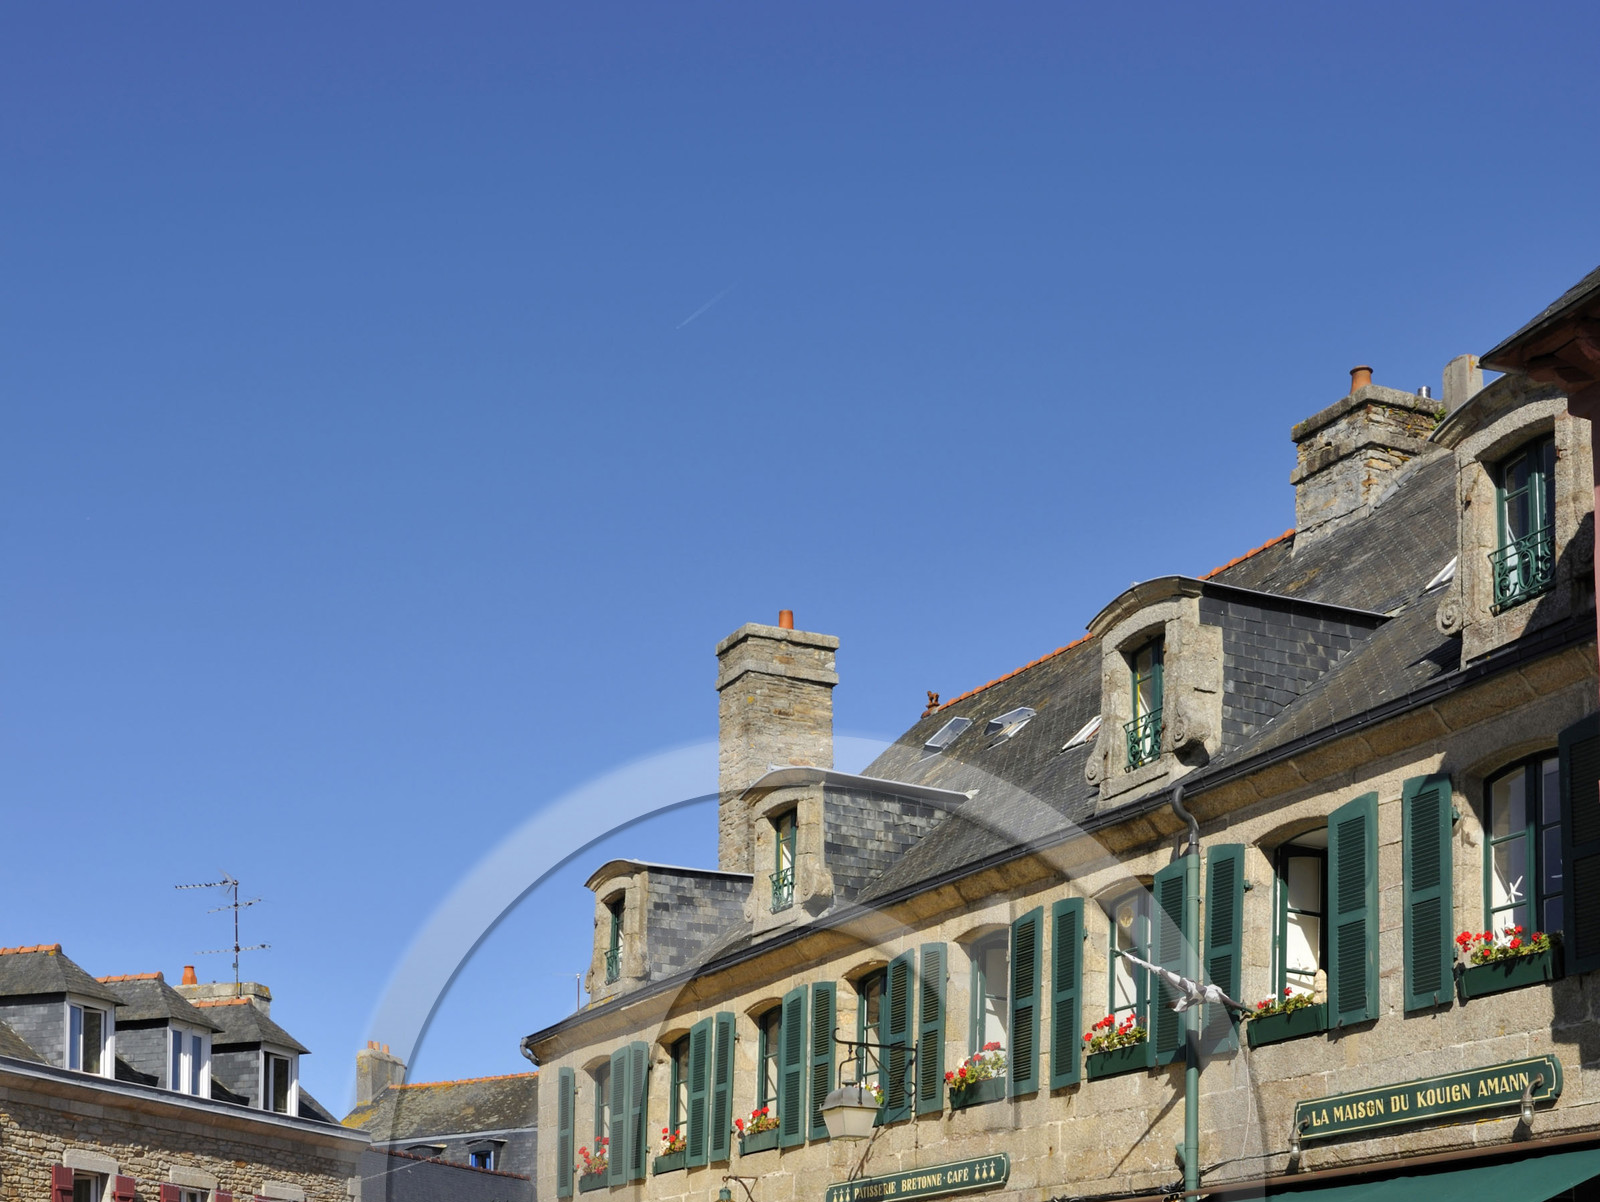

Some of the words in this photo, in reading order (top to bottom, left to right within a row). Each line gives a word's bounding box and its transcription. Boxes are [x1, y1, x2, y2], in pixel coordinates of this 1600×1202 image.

[1312, 1109, 1329, 1127] LA
[1334, 1101, 1385, 1122] MAISON
[1391, 1094, 1410, 1113] DU
[1417, 1082, 1471, 1108] KOUIGN
[1477, 1071, 1529, 1097] AMANN
[854, 1181, 897, 1200] PATISSERIE
[901, 1173, 942, 1192] BRETONNE
